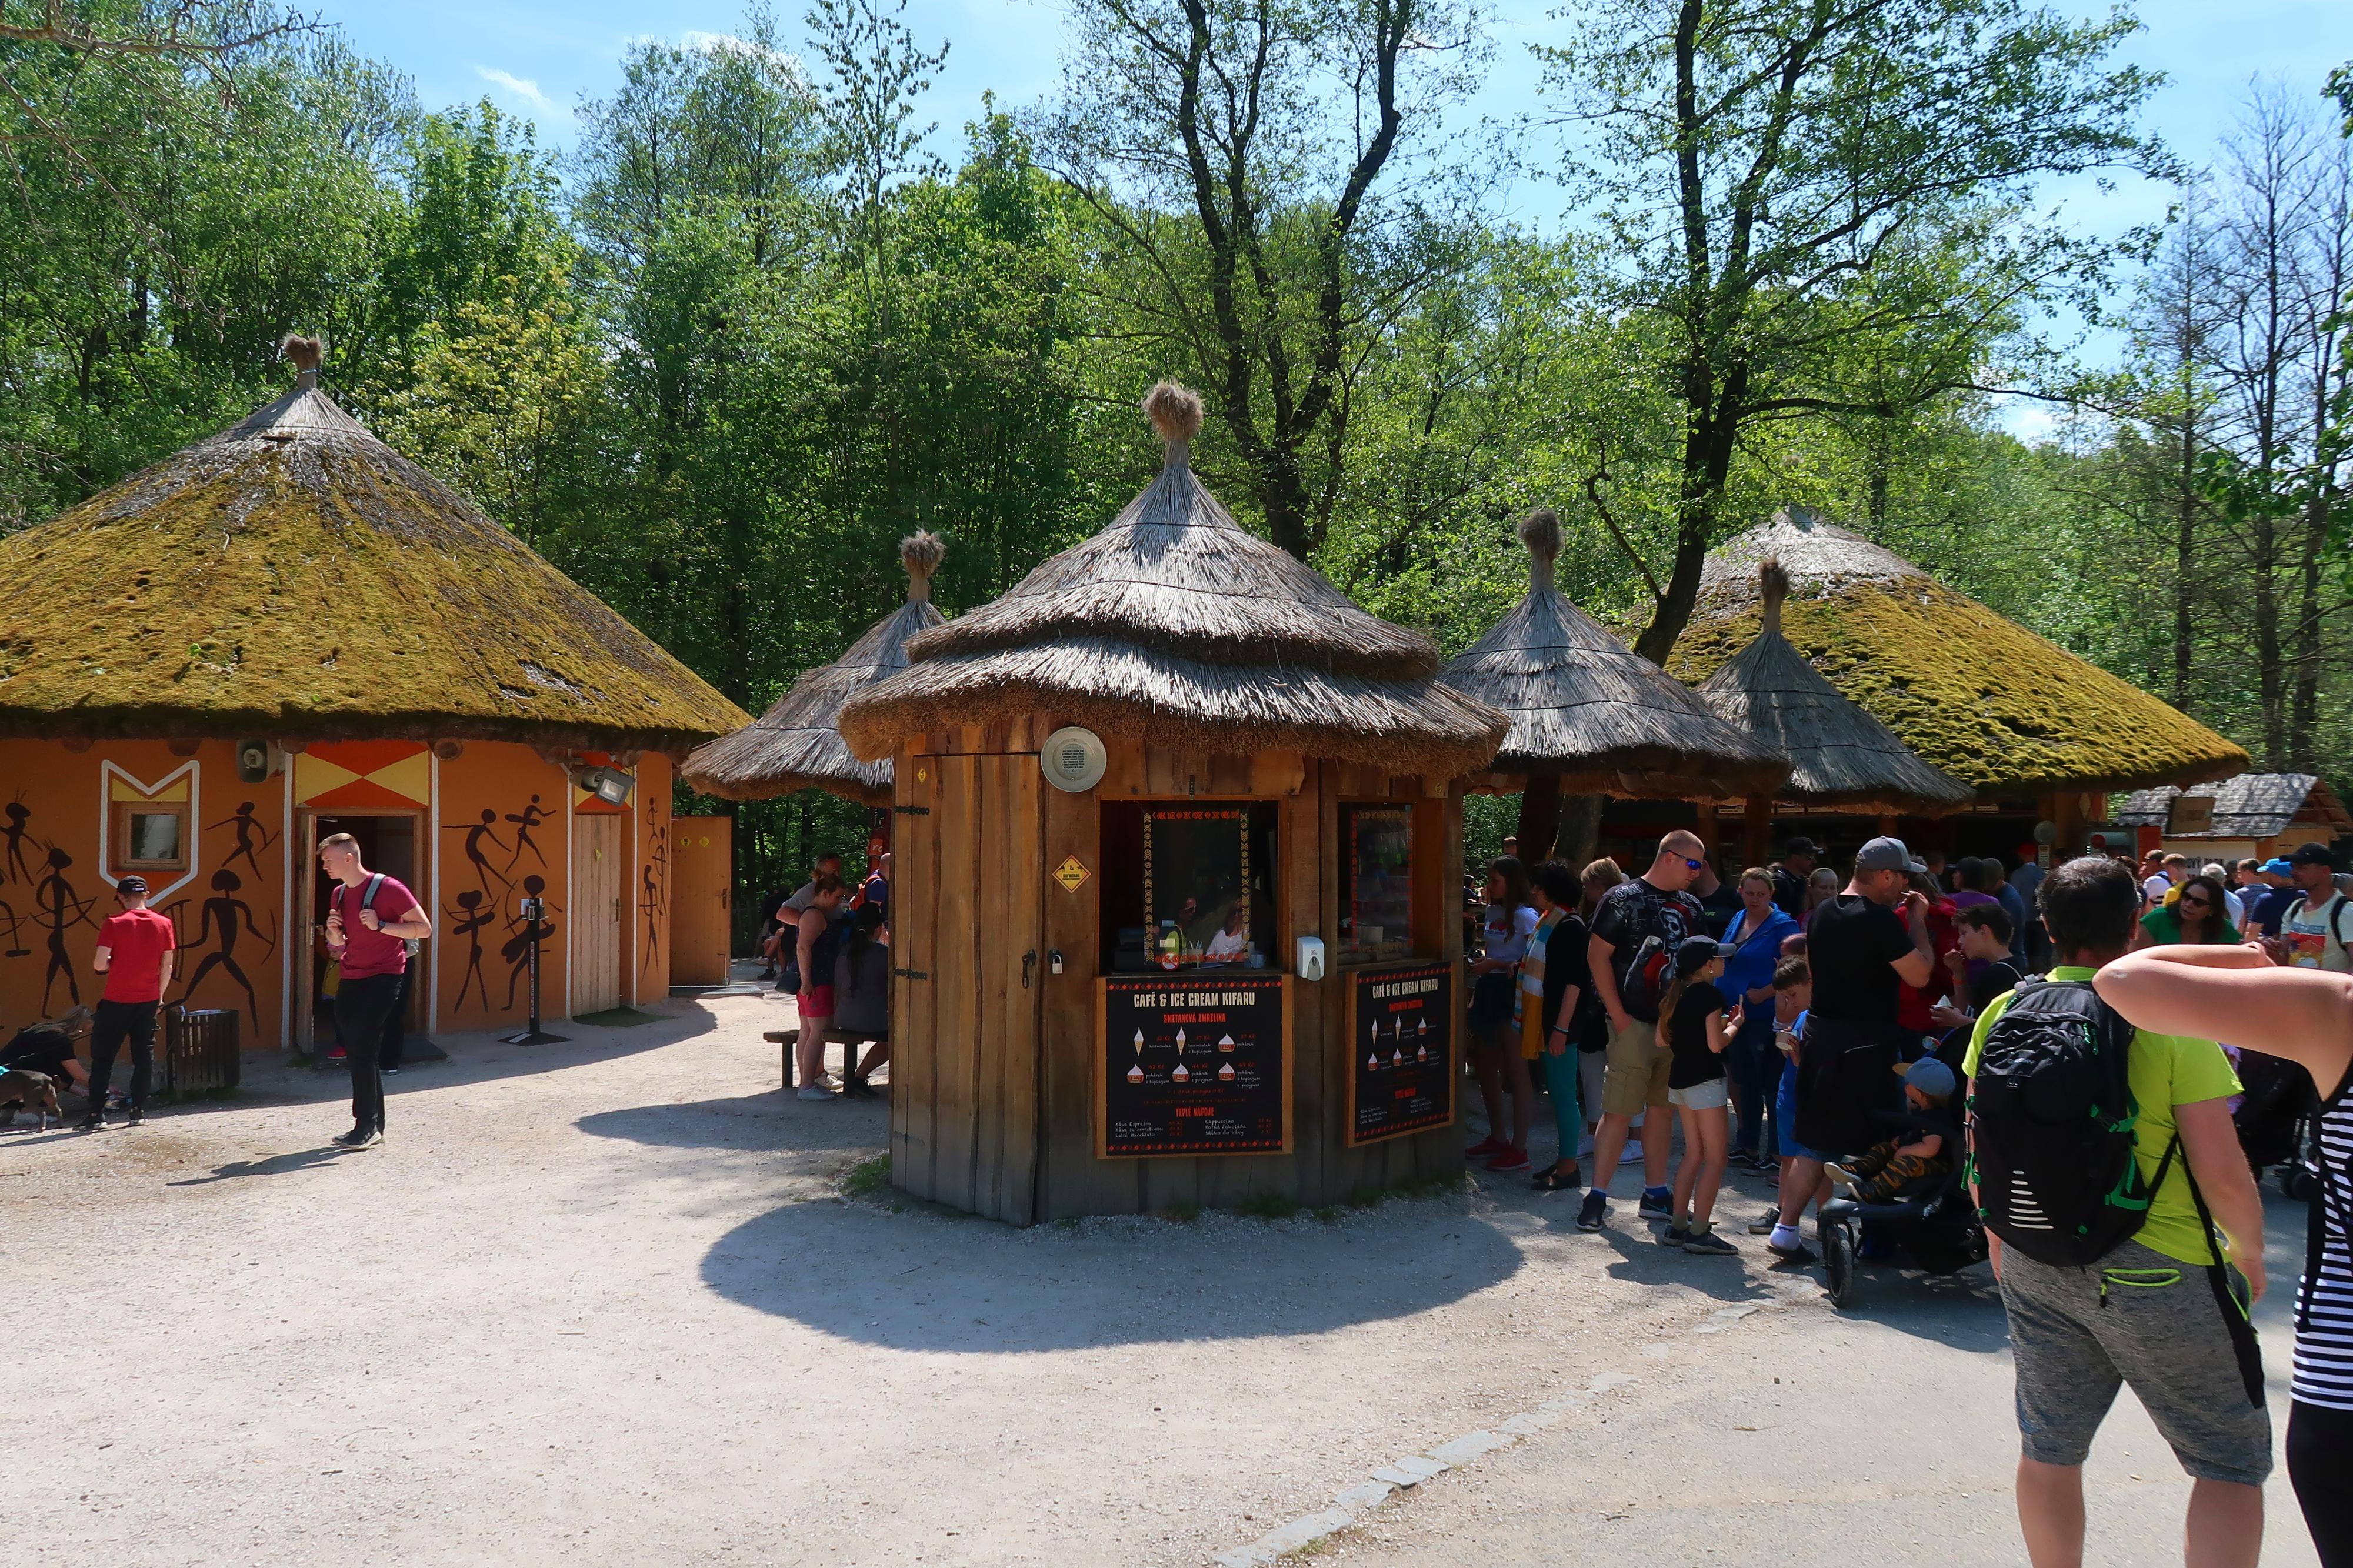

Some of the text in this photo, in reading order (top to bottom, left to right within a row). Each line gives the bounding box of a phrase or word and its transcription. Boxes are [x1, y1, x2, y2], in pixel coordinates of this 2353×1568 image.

[1372, 982, 1385, 999] CAFÉ
[1392, 983, 1400, 996] ICE
[1402, 980, 1418, 995] CREAM
[1420, 979, 1438, 992] KIFARU
[1134, 992, 1255, 1007] CAFÉ & ICE CREAM KIFARU
[1164, 1012, 1226, 1023] SMETANOVÁ ZMRZLINA
[1176, 1106, 1214, 1117] TEPLÉ NÁPOJE
